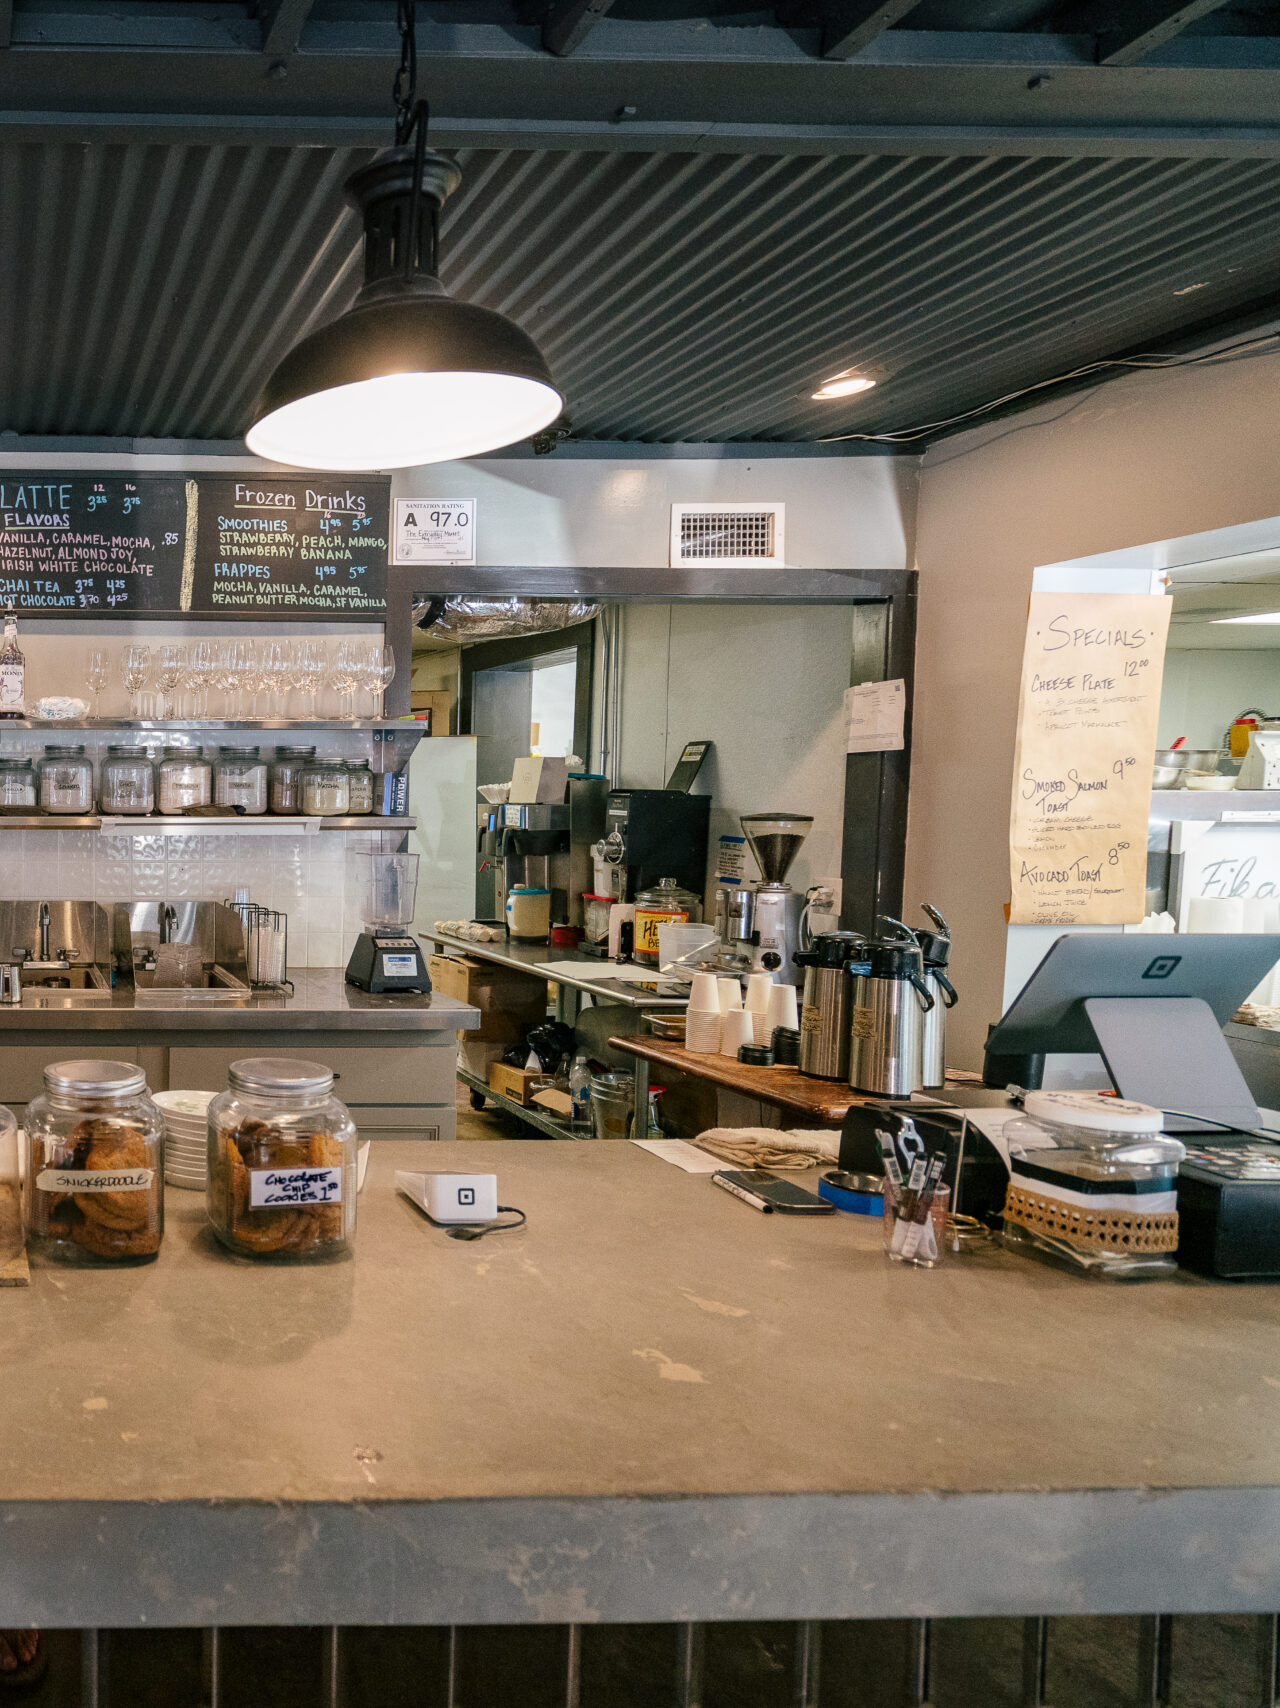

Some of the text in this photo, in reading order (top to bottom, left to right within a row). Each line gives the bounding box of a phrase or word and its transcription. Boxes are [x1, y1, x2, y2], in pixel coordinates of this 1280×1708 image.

[0, 485, 72, 509] LATTE
[94, 484, 104, 492] 12
[235, 484, 366, 511] Frozen Drinks
[4, 514, 70, 526] FLAVORS
[218, 516, 288, 532] SMOOTHIES
[404, 511, 468, 527] A 97.0
[53, 533, 111, 546] CARAMEL,
[112, 536, 155, 550] MOCHA,
[220, 533, 299, 547] STRAWBERRY,
[302, 535, 345, 548] PEACH,
[348, 537, 388, 550] MANGO,
[58, 547, 107, 560] ALMOND
[220, 545, 352, 560] STRAWBERRY BANANA
[2, 560, 154, 576] IRISH WHITE CHOCOLATE
[214, 563, 270, 578] FRAPPES
[34, 581, 60, 592] TEA
[214, 581, 368, 597] MOCHA, VANILLA, CARAMEL,
[21, 595, 75, 607] CHOCOLATE
[212, 594, 254, 604] PEANUT
[256, 595, 298, 605] BUTTER
[336, 597, 347, 607] SF
[349, 598, 387, 608] VANILLA
[1043, 615, 1145, 651] SPECIALS
[1031, 674, 1116, 692] CHEESE PLATE
[1022, 768, 1108, 800] SMOKED SALMON
[396, 777, 405, 811] POWER
[1036, 791, 1072, 815] TOAST
[1020, 856, 1103, 886] AVOCADO TOAST
[57, 1174, 147, 1188] SNICKERDOODLE
[265, 1171, 332, 1185] CHOCOLATE
[282, 1183, 310, 1192] CHIP
[265, 1192, 318, 1203] COOKIES
